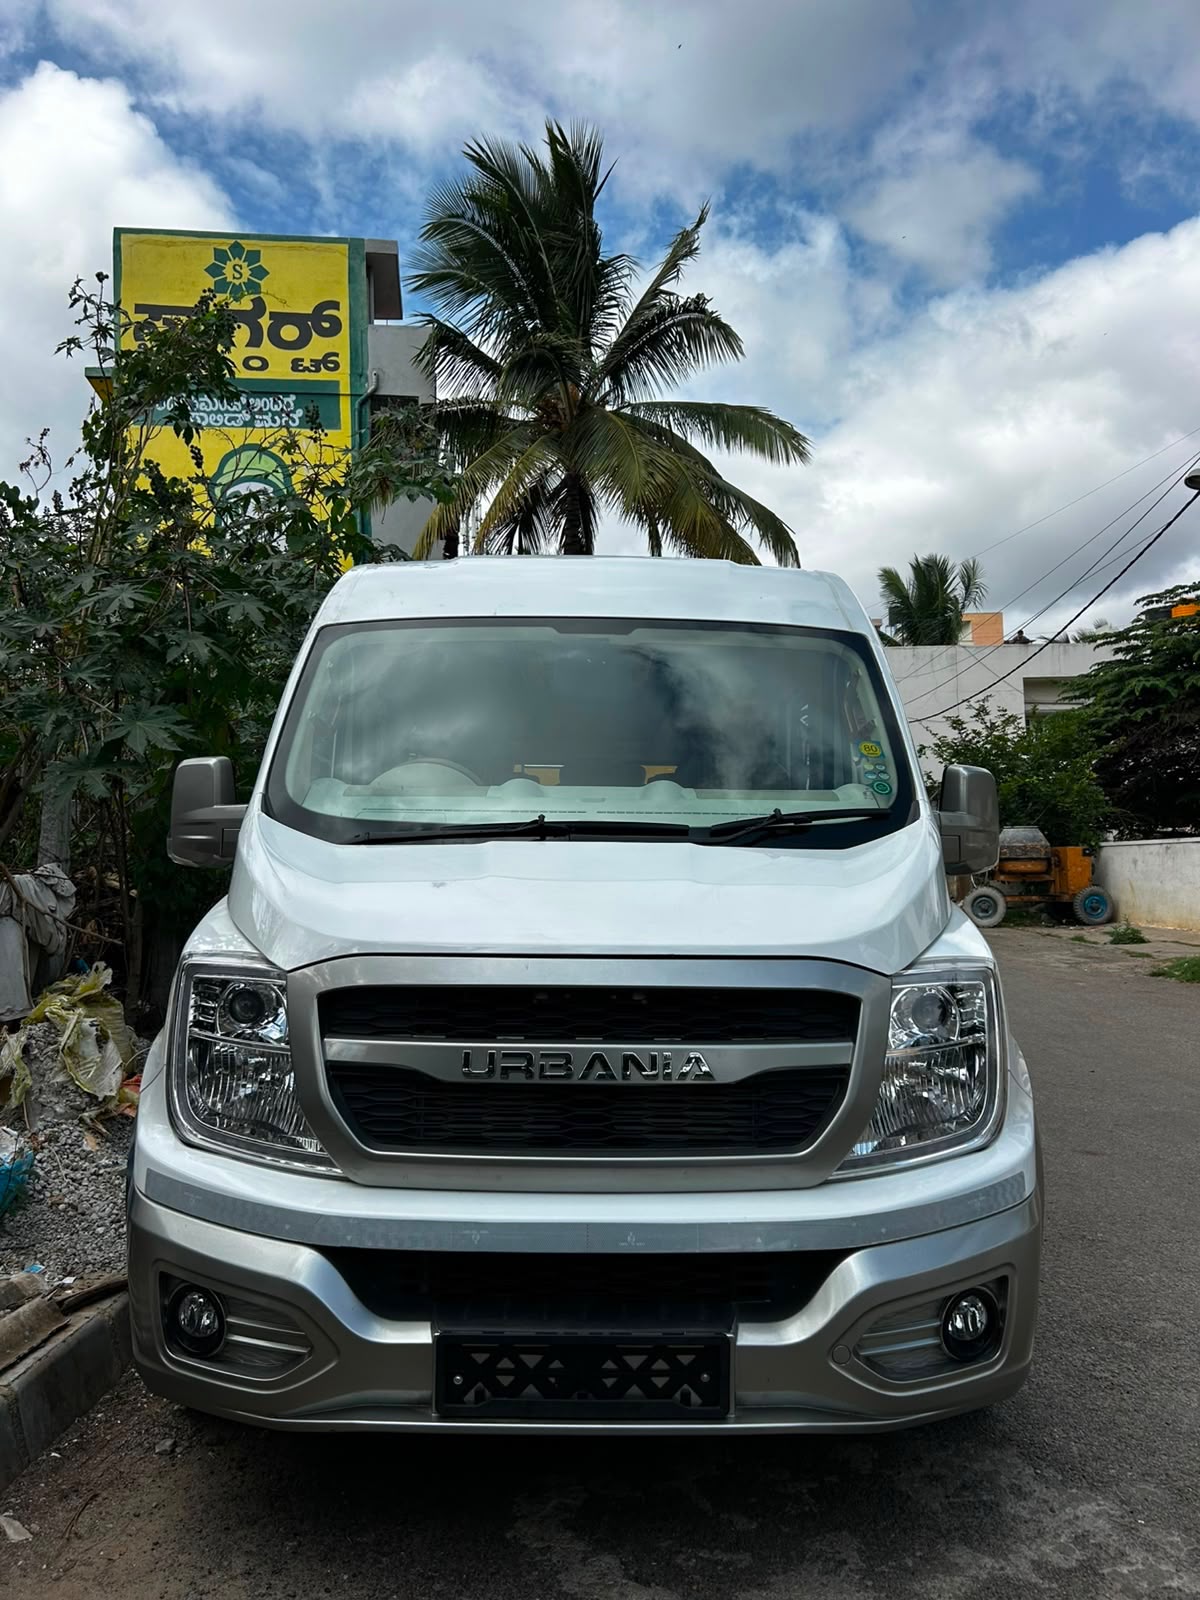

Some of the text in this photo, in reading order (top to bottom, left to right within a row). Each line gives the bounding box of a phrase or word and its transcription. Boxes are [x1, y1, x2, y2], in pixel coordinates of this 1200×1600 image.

[232, 264, 243, 280] S
[133, 296, 342, 350] ಗರ್
[863, 744, 878, 752] 80
[462, 1049, 716, 1081] URBANIA
